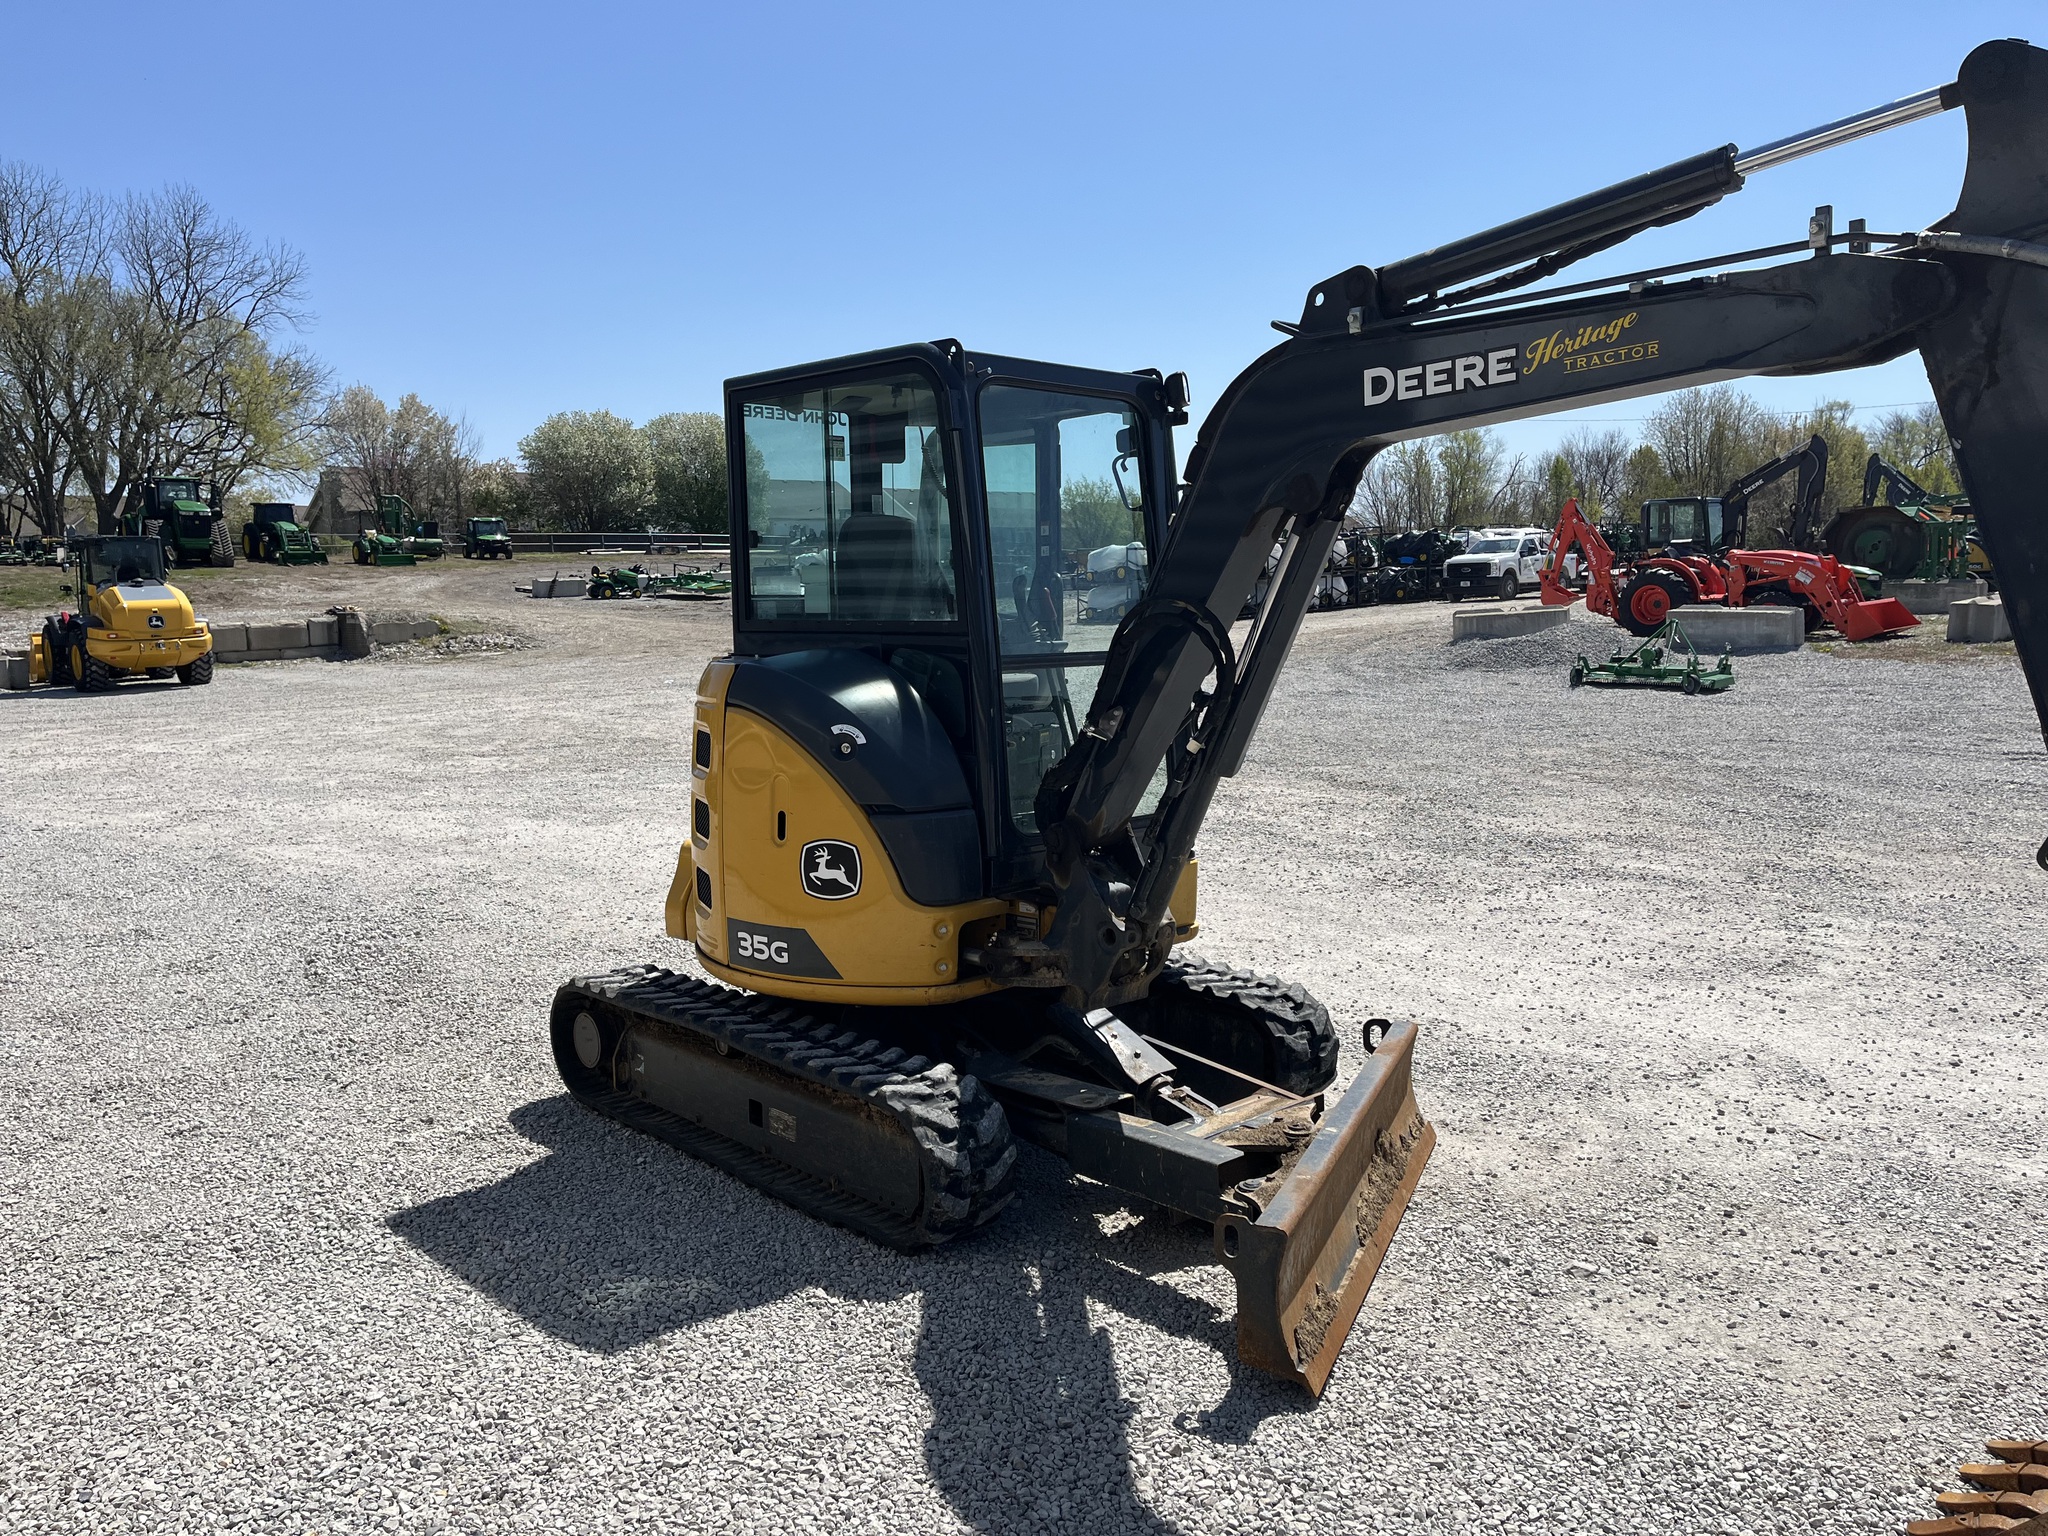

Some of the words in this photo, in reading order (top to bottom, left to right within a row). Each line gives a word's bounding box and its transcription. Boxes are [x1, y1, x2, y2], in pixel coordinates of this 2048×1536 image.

[1523, 312, 1640, 375] Heritage
[1564, 343, 1659, 371] TRACTOR
[1363, 347, 1517, 407] DEERE
[1742, 478, 1765, 495] DEERE
[737, 931, 789, 964] 35G
